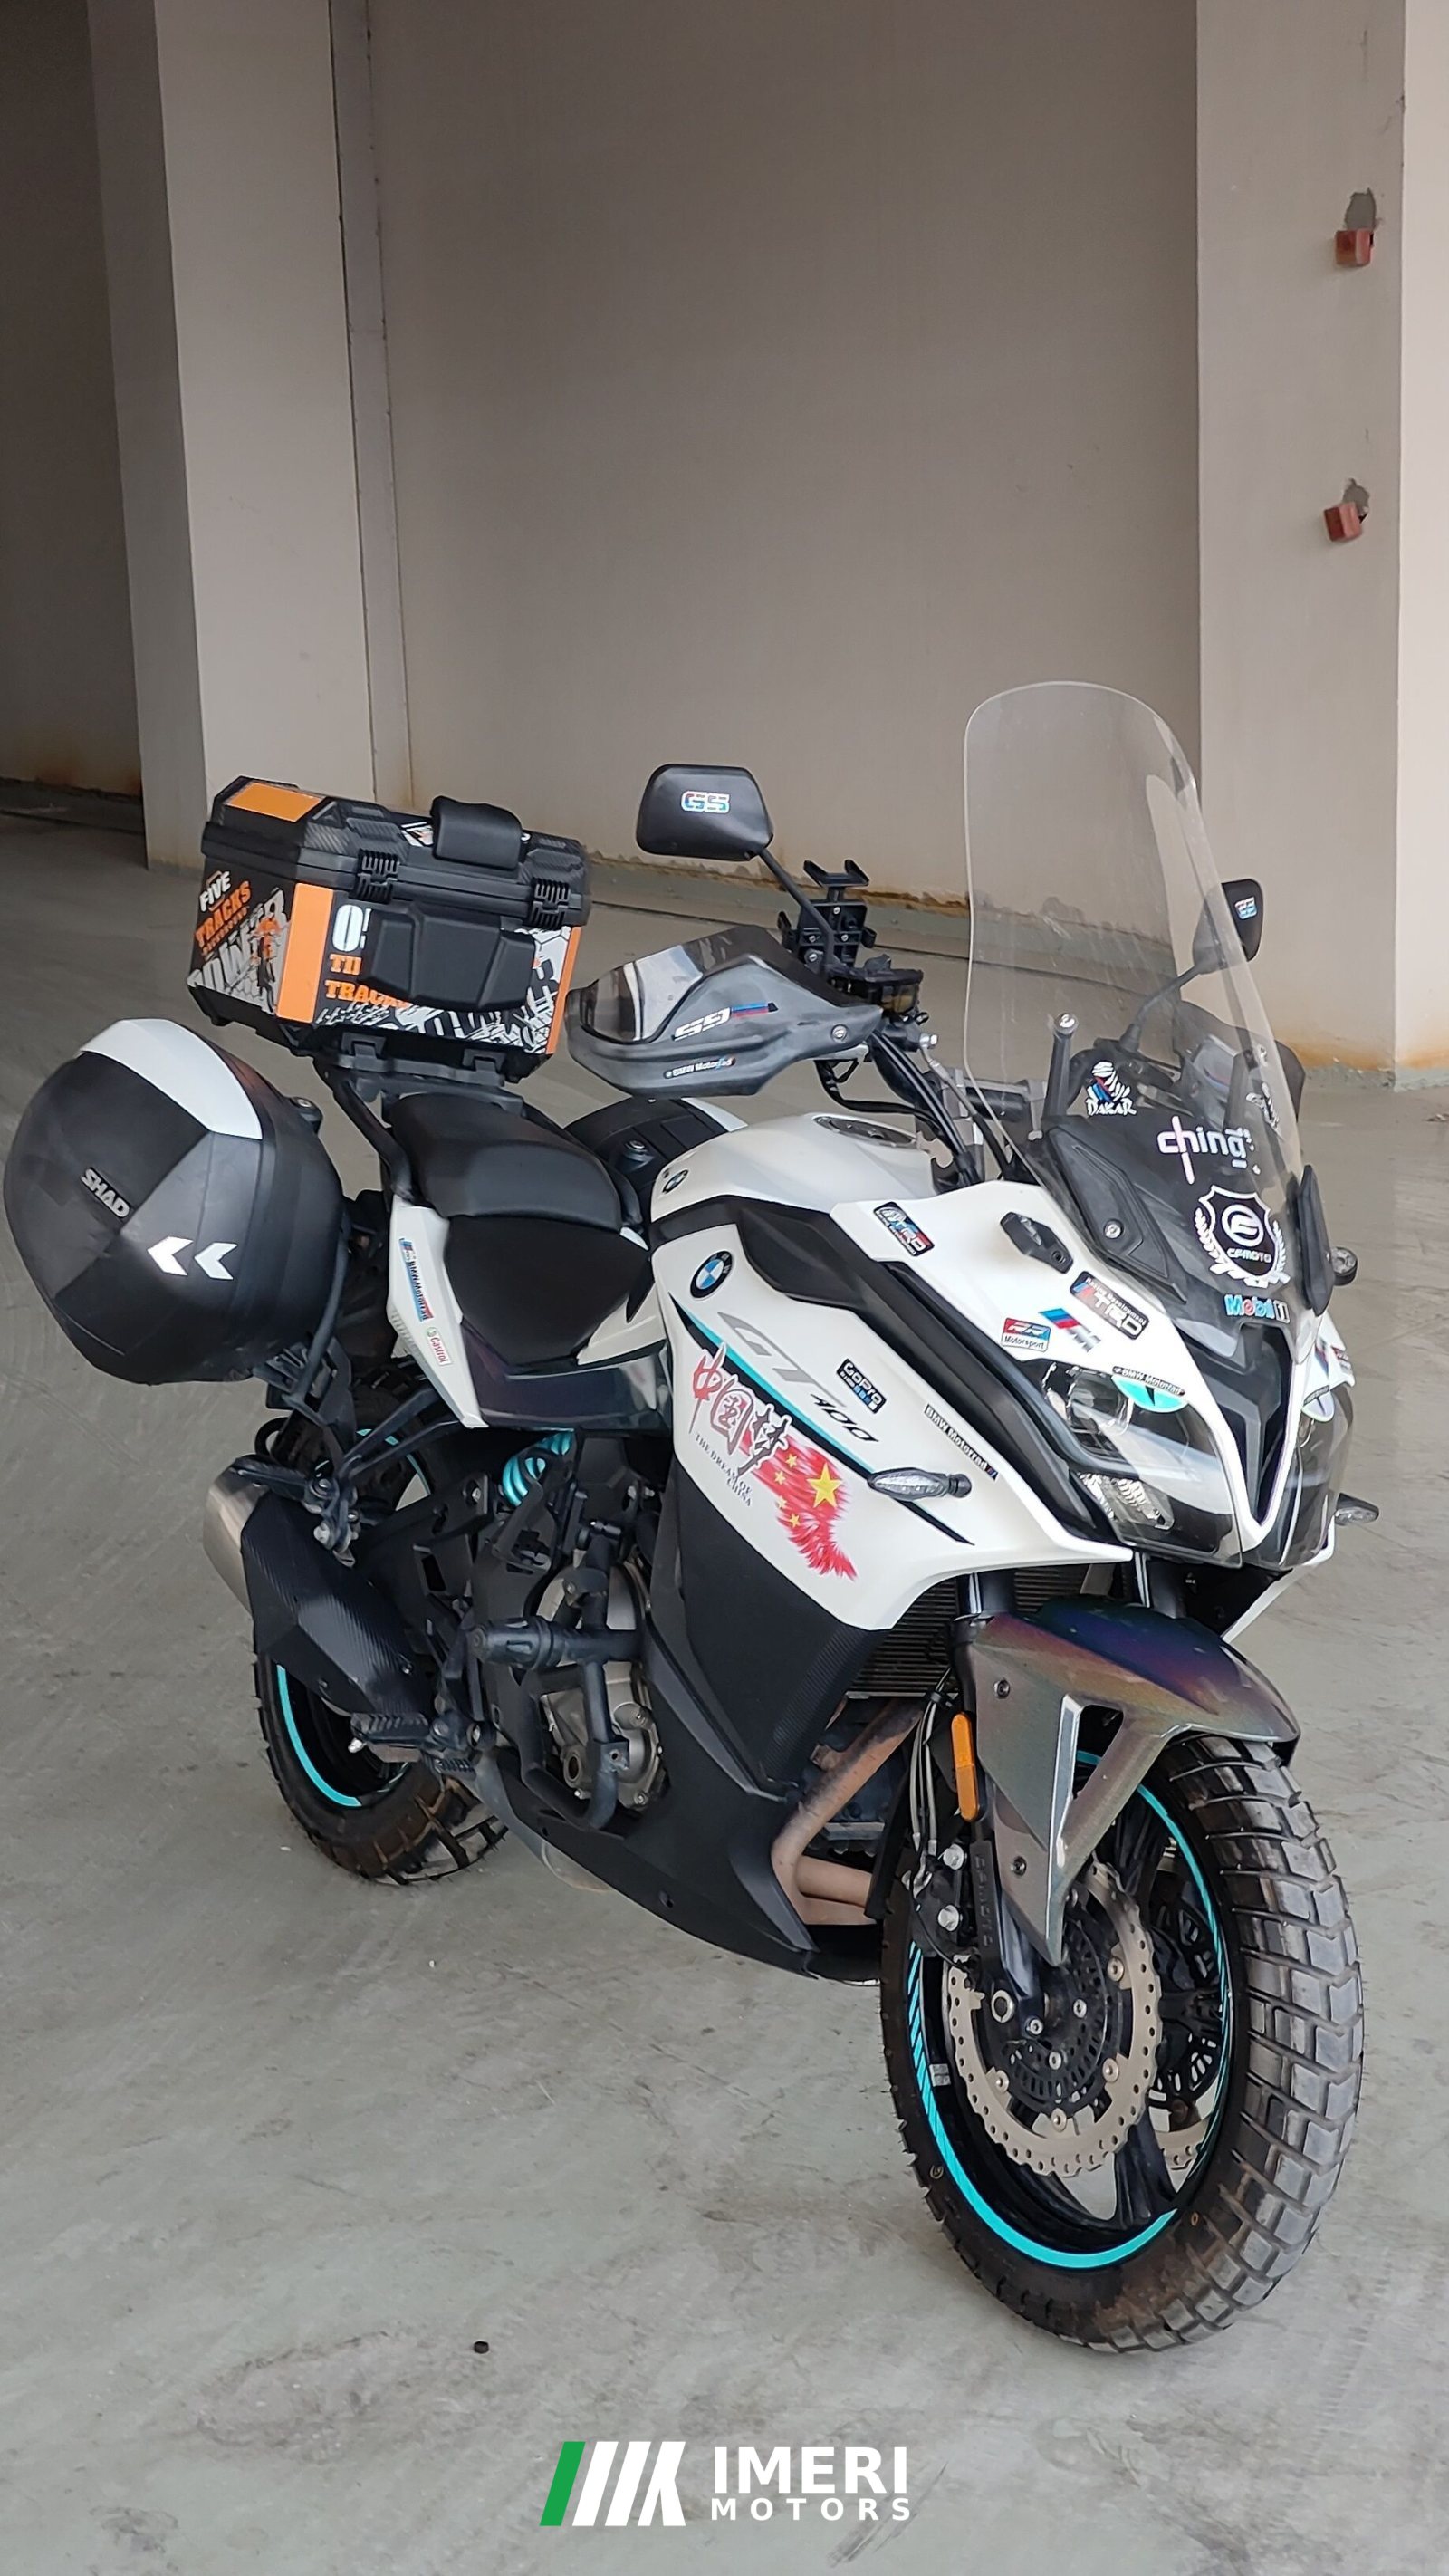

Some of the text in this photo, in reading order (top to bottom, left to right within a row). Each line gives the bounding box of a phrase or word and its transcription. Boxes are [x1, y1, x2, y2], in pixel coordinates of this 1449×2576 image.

[681, 790, 730, 813] GS
[200, 871, 231, 911] FIVE
[195, 880, 251, 949] TRACKS
[1086, 1098, 1137, 1115] DAKAR
[81, 1168, 130, 1217] SHAD
[1227, 1247, 1272, 1264] CFMOTO
[1094, 1292, 1143, 1336] TRD
[1224, 1294, 1275, 1319] Mobil
[430, 1336, 450, 1363] Castrol
[1004, 1335, 1045, 1350] Motorsport
[843, 1362, 882, 1405] GoPro
[1121, 1368, 1145, 1382] BMW
[811, 1393, 879, 1442] 400
[925, 1405, 987, 1472] BMW Motorrad
[696, 1433, 753, 1494] THE DREAM OF
[727, 1476, 752, 1506] CHINA
